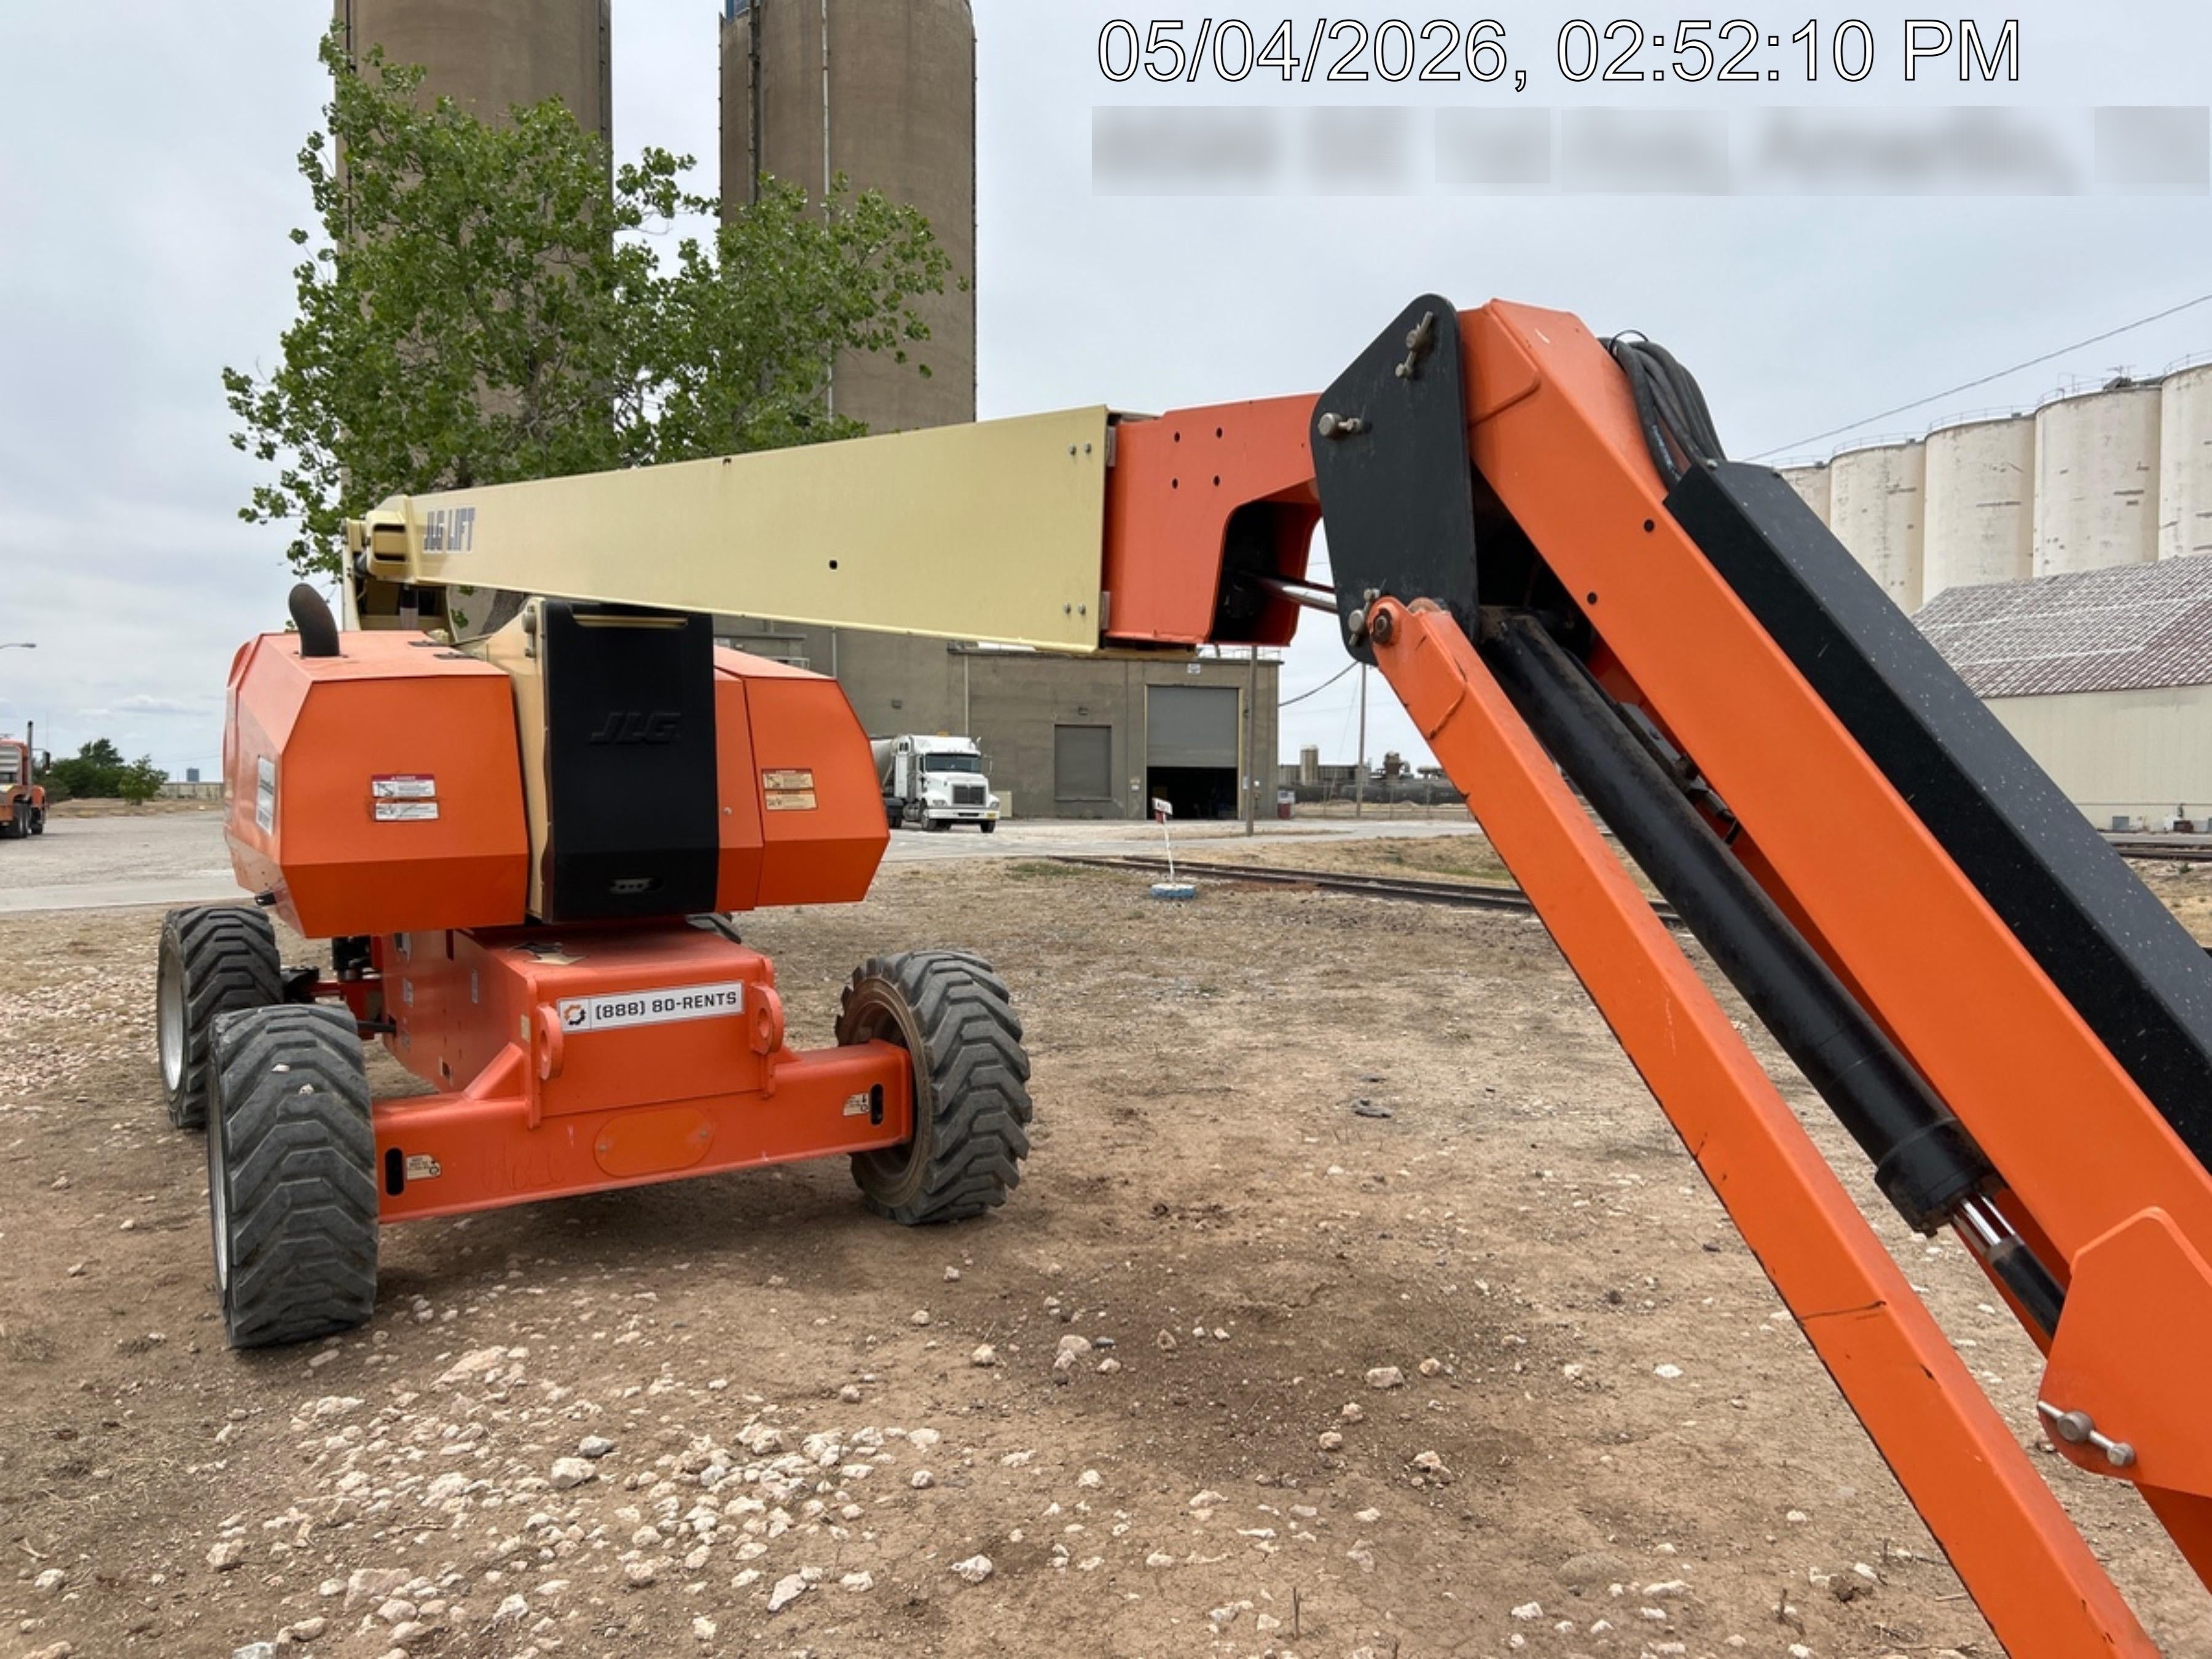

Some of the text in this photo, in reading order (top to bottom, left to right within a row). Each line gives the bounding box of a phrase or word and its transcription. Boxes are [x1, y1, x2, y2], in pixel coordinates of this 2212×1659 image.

[424, 508, 475, 551] JLG LIFT
[589, 711, 681, 744] JLG
[596, 991, 737, 1019] (888) 80-RENTS
